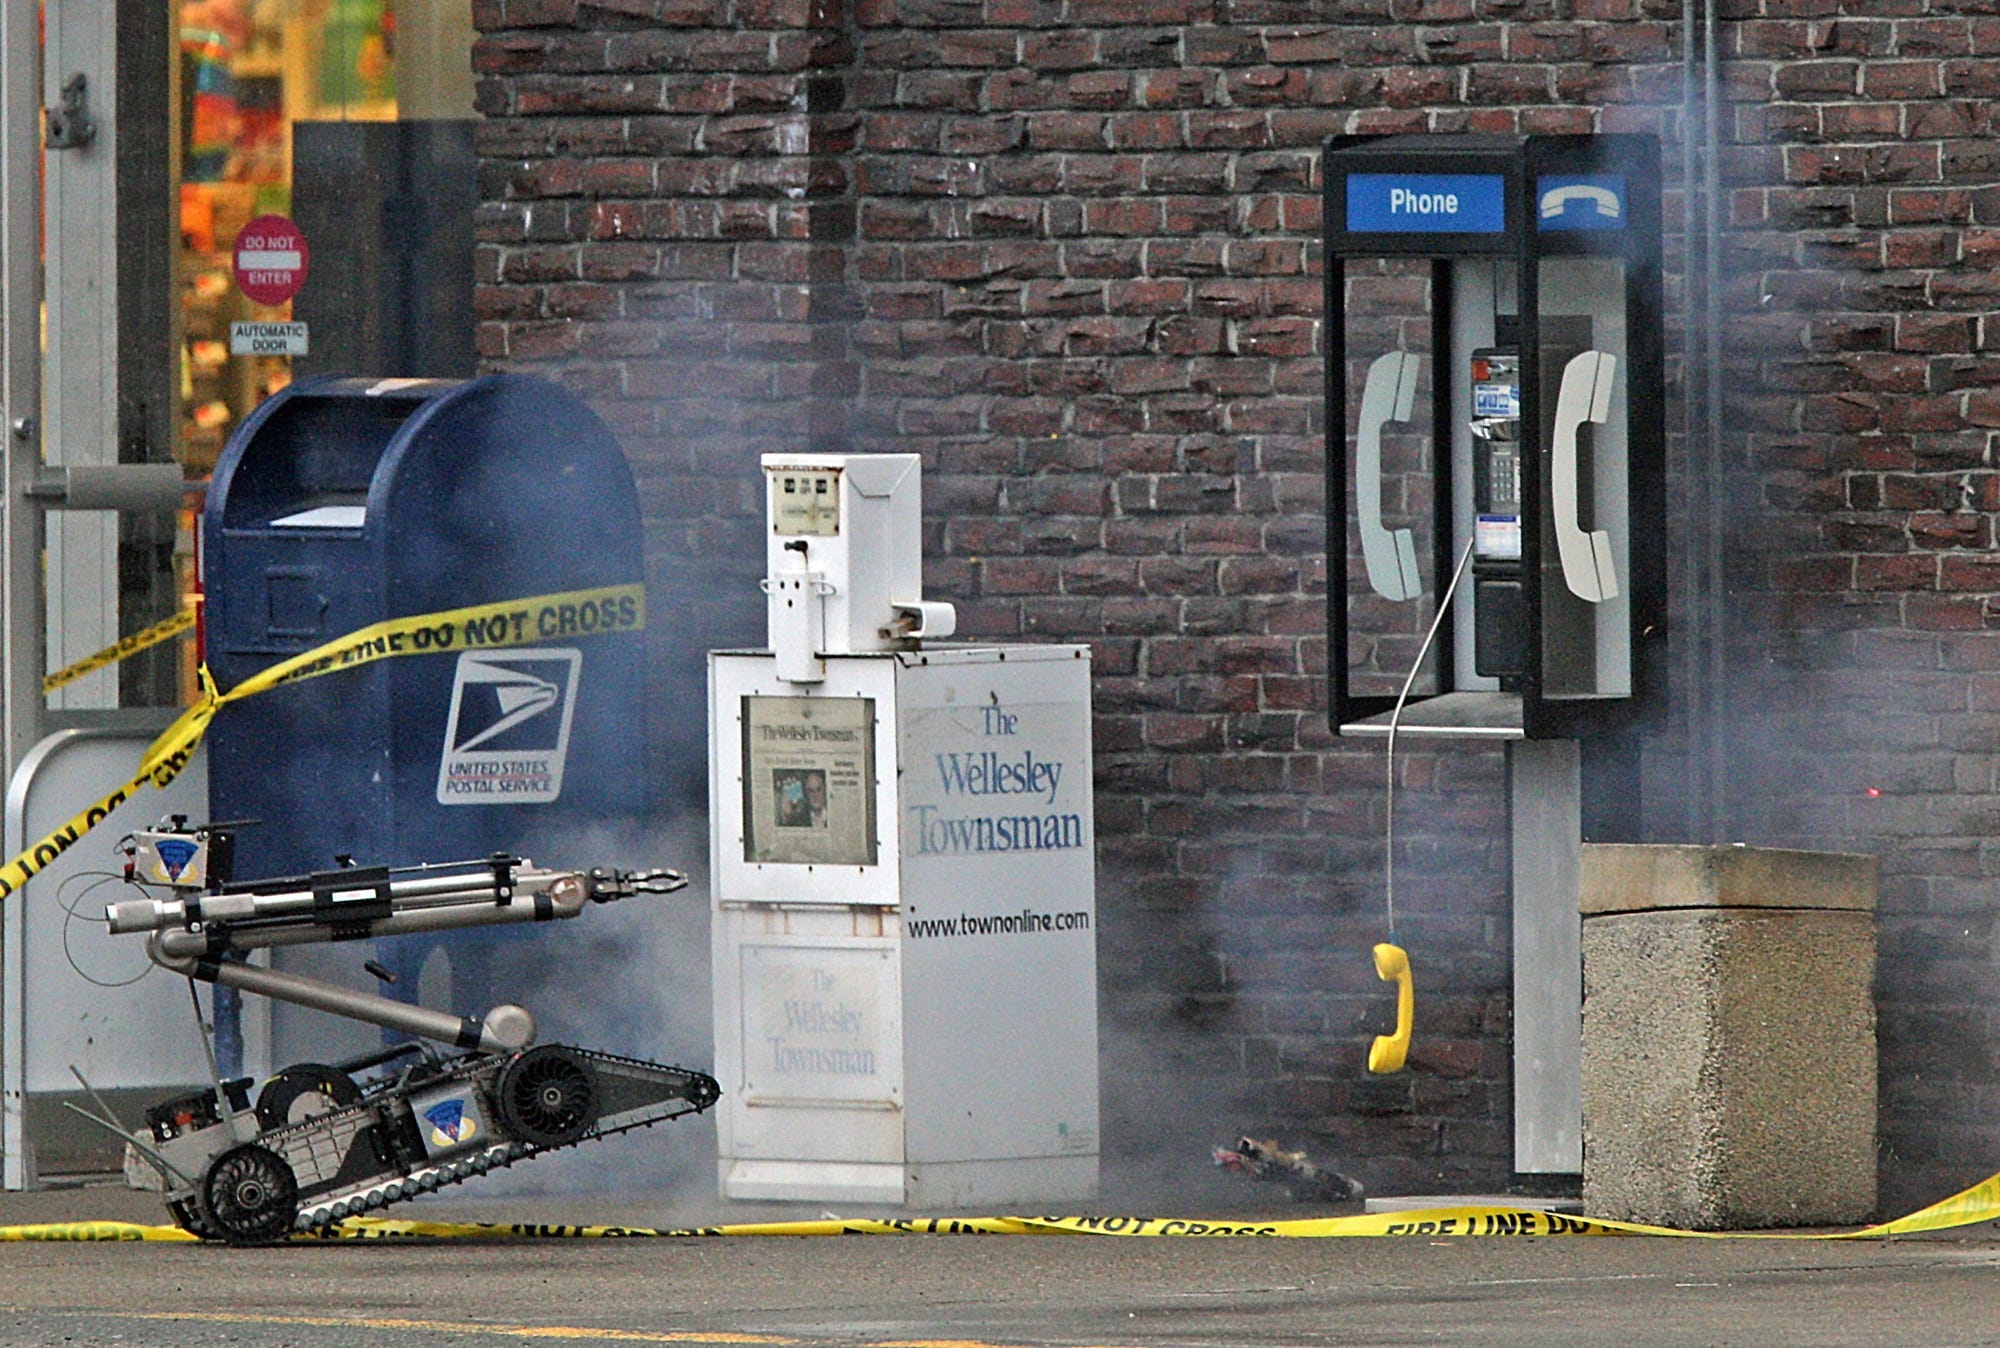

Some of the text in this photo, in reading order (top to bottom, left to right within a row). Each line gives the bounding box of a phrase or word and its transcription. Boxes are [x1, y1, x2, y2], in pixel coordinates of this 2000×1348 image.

[1390, 187, 1459, 214] Phone
[245, 236, 295, 249] DO NOT
[248, 271, 292, 285] ENTER
[235, 325, 303, 338] AUTOMATIC
[252, 339, 287, 351] DOOR
[411, 626, 454, 649] DO
[464, 610, 529, 647] NOT
[536, 595, 637, 638] CROSS
[979, 704, 1018, 737] The
[448, 761, 548, 776] UNITED STATES
[934, 750, 1063, 804] Wellesley
[446, 778, 552, 793] POSTAL SERVICE
[909, 803, 1083, 857] Townsman
[908, 908, 1090, 938] www.townonline.com
[766, 1035, 876, 1075] Townsman
[1464, 1213, 1537, 1236] LINE
